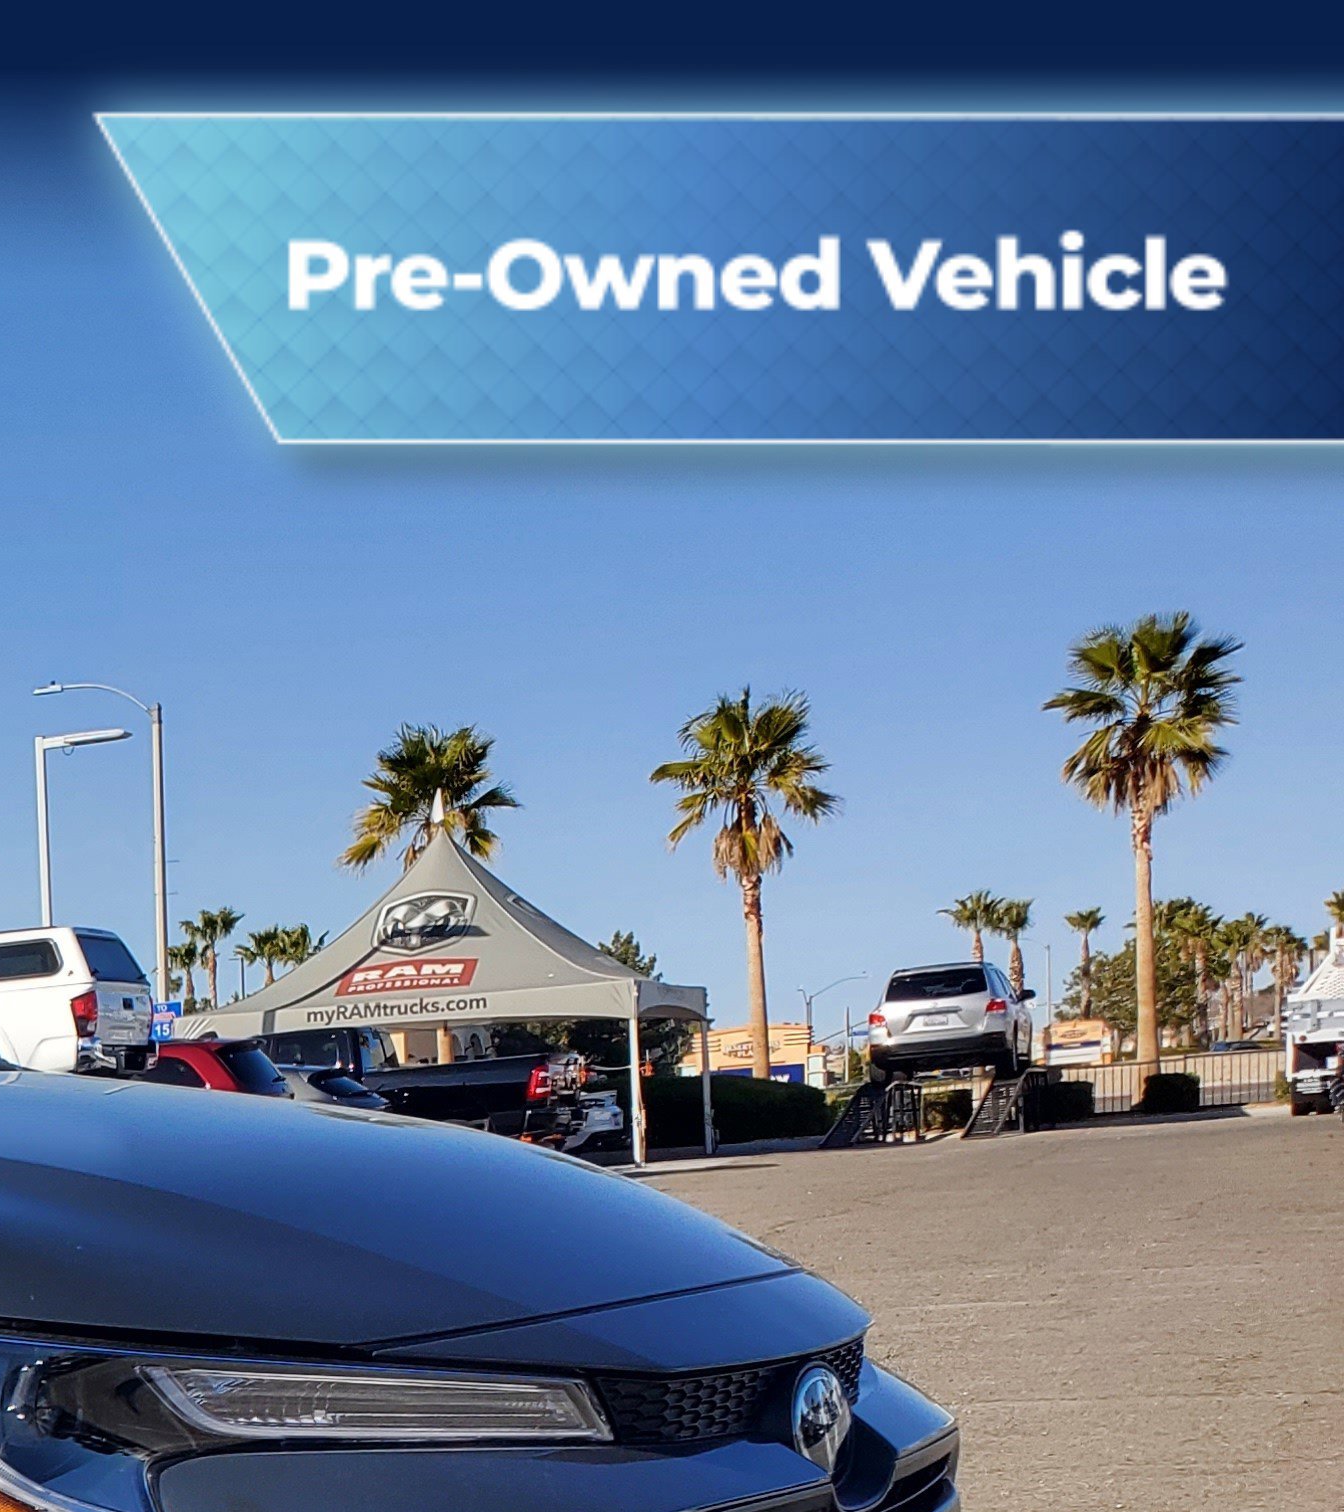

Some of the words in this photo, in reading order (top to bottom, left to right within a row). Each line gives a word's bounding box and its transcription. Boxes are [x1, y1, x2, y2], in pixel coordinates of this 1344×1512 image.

[352, 963, 465, 983] RAM
[347, 977, 460, 993] PROFESSIONAL
[156, 1004, 168, 1012] TO
[306, 996, 487, 1026] myRAMtrucks.com
[155, 1023, 170, 1036] 15
